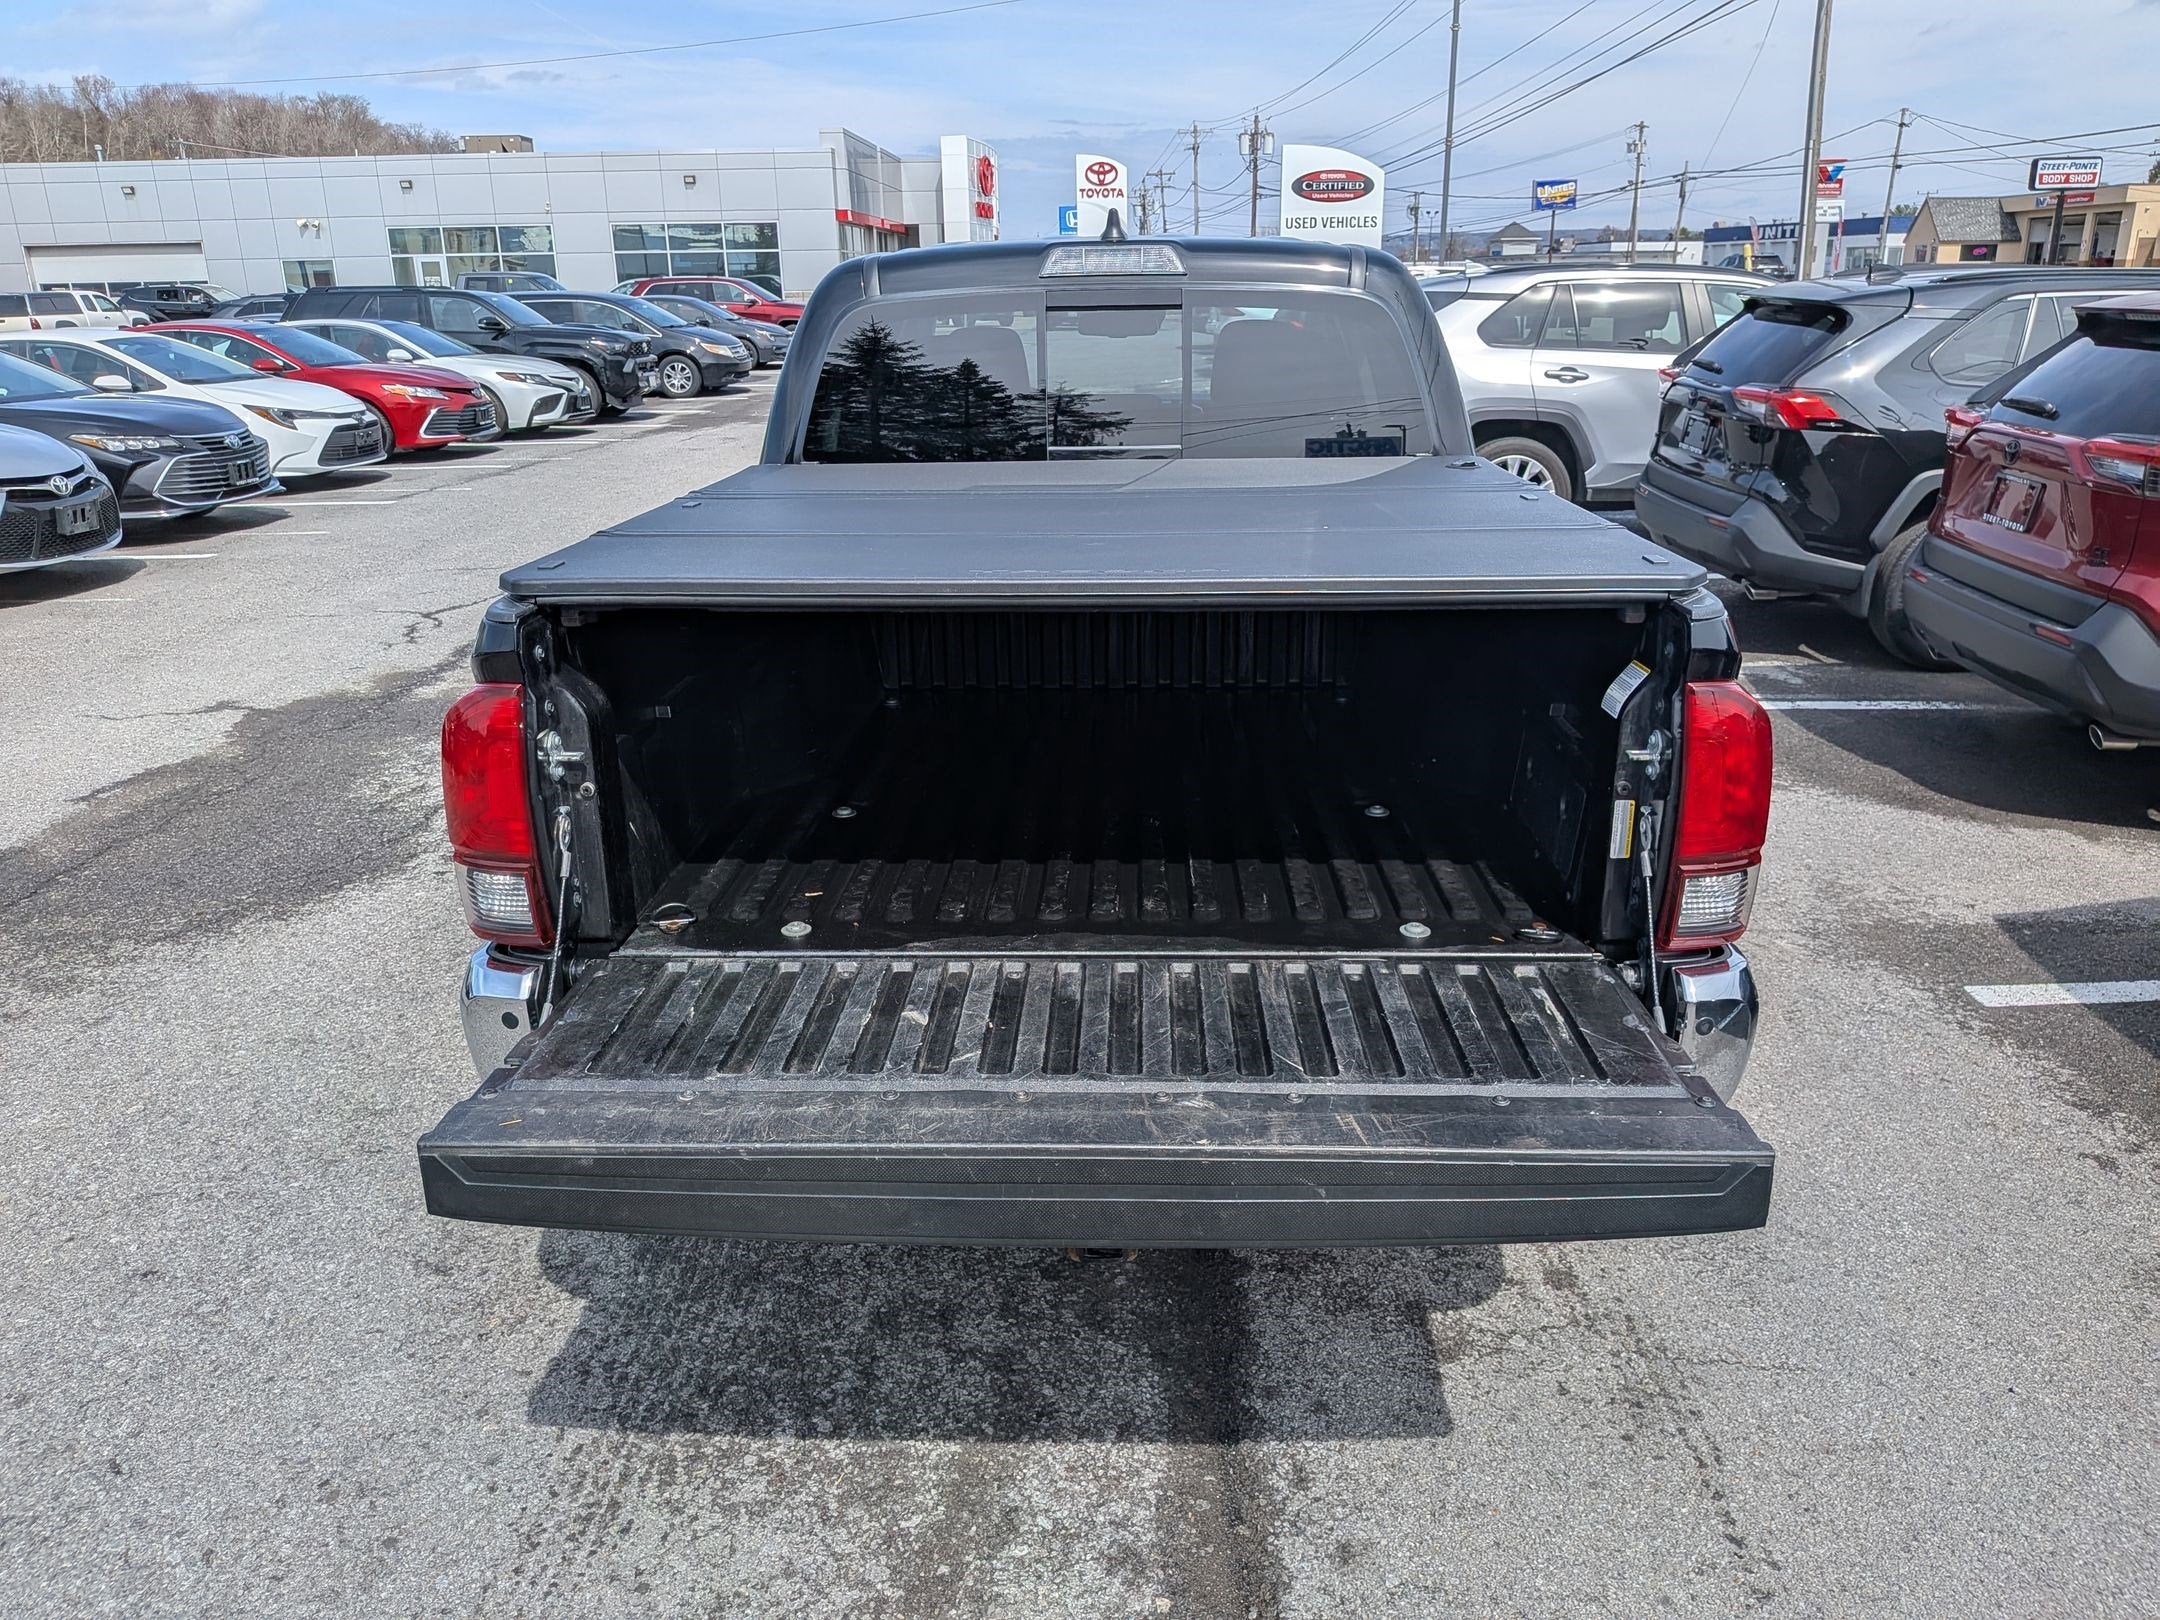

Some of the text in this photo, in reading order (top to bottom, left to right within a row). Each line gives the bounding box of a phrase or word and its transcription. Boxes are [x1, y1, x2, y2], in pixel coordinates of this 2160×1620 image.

[2042, 174, 2093, 183] BODY SHOP
[1079, 188, 1125, 198] TOYOTA
[1285, 216, 1378, 229] USED VEHICLES
